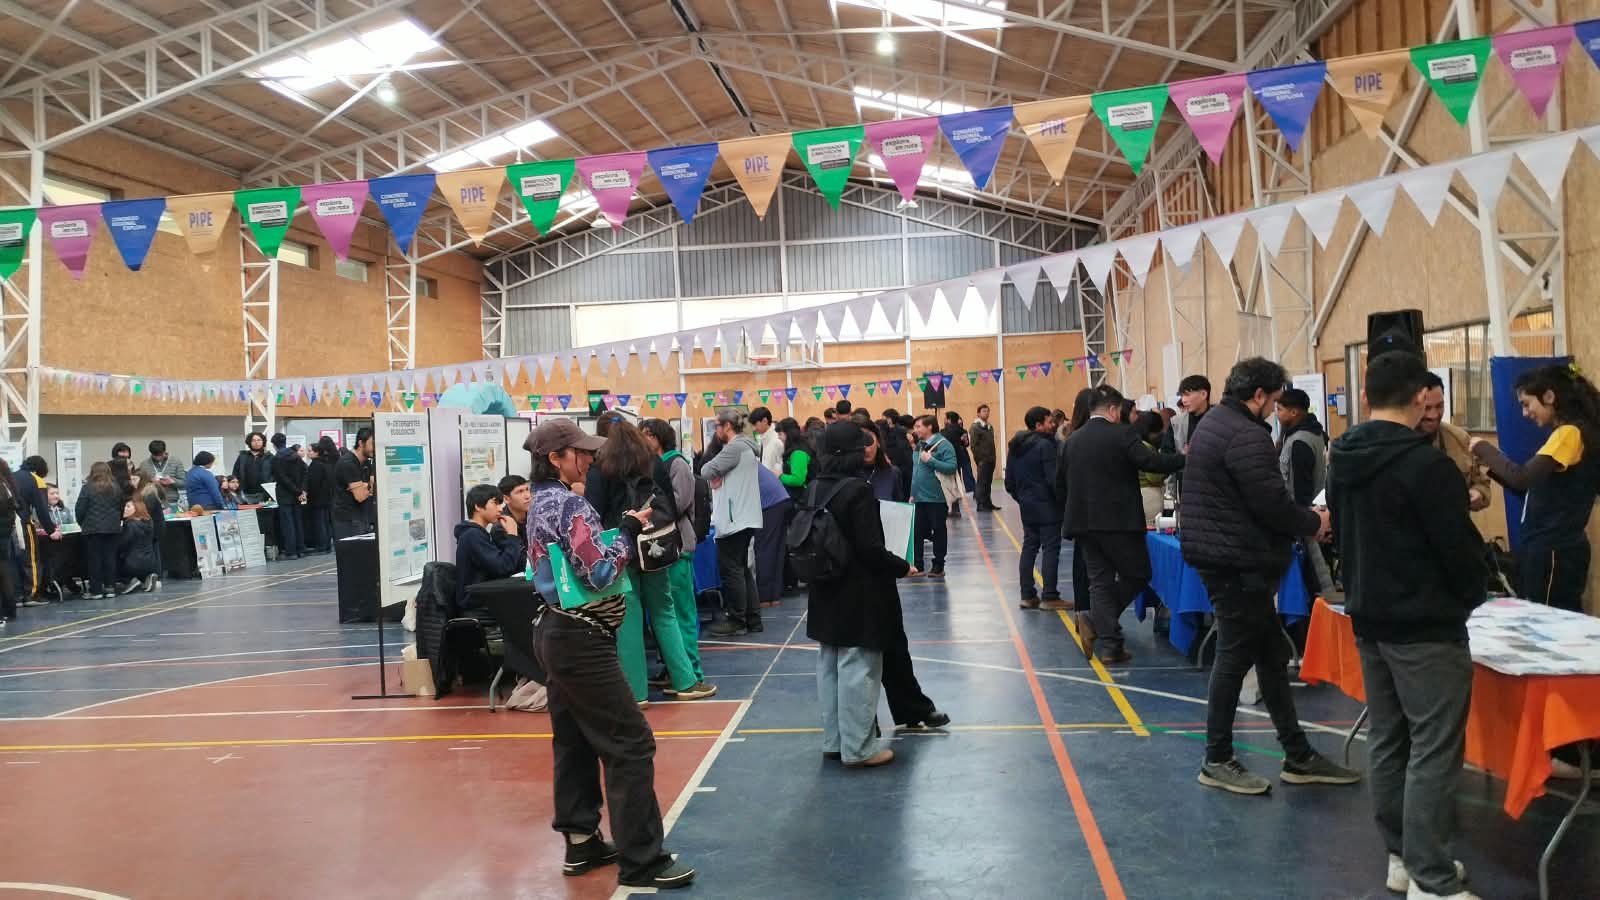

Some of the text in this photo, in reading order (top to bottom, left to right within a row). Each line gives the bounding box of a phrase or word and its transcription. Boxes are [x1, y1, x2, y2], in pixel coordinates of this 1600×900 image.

[1355, 72, 1383, 94] PIPE
[1040, 120, 1067, 136] PIPE
[745, 156, 770, 175] PIPE
[460, 186, 486, 204] PIPE
[190, 212, 213, 228] PIPE
